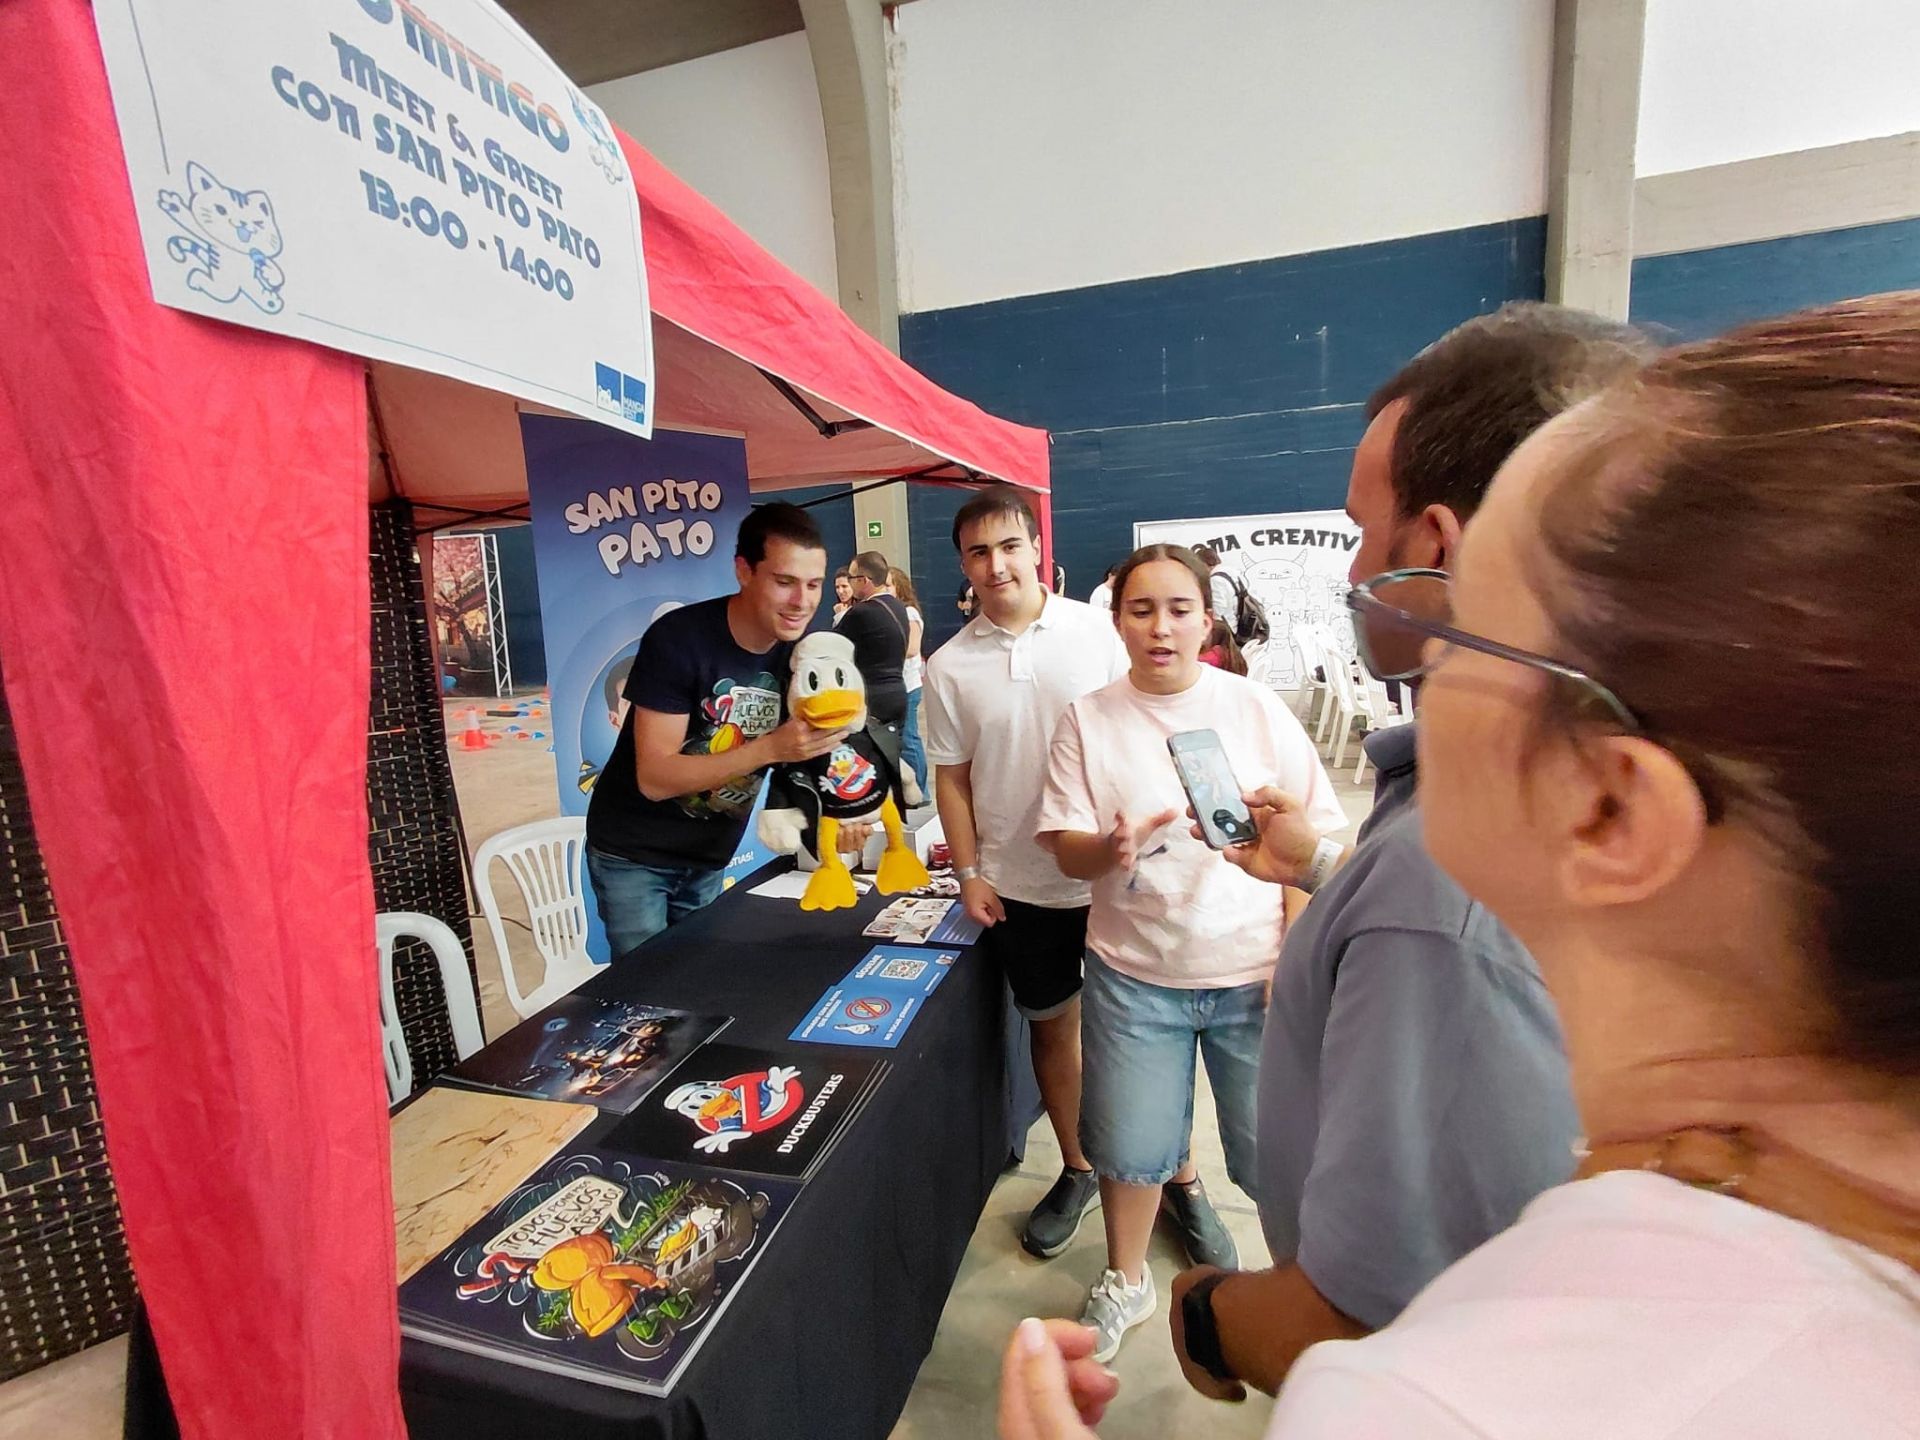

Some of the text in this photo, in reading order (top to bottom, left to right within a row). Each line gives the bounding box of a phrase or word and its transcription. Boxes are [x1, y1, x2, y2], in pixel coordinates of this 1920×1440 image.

[329, 31, 563, 210] MEET & GREET
[271, 65, 601, 268] CON SAN PITO PATO
[359, 168, 469, 250] 13:00
[493, 234, 574, 301] 14:00
[565, 479, 721, 534] SAN PITO
[1250, 528, 1360, 551] CREATIV
[598, 519, 714, 575] PATO
[776, 1073, 844, 1154] DUCKBUSTERS
[528, 1187, 602, 1247] HUEVOS
